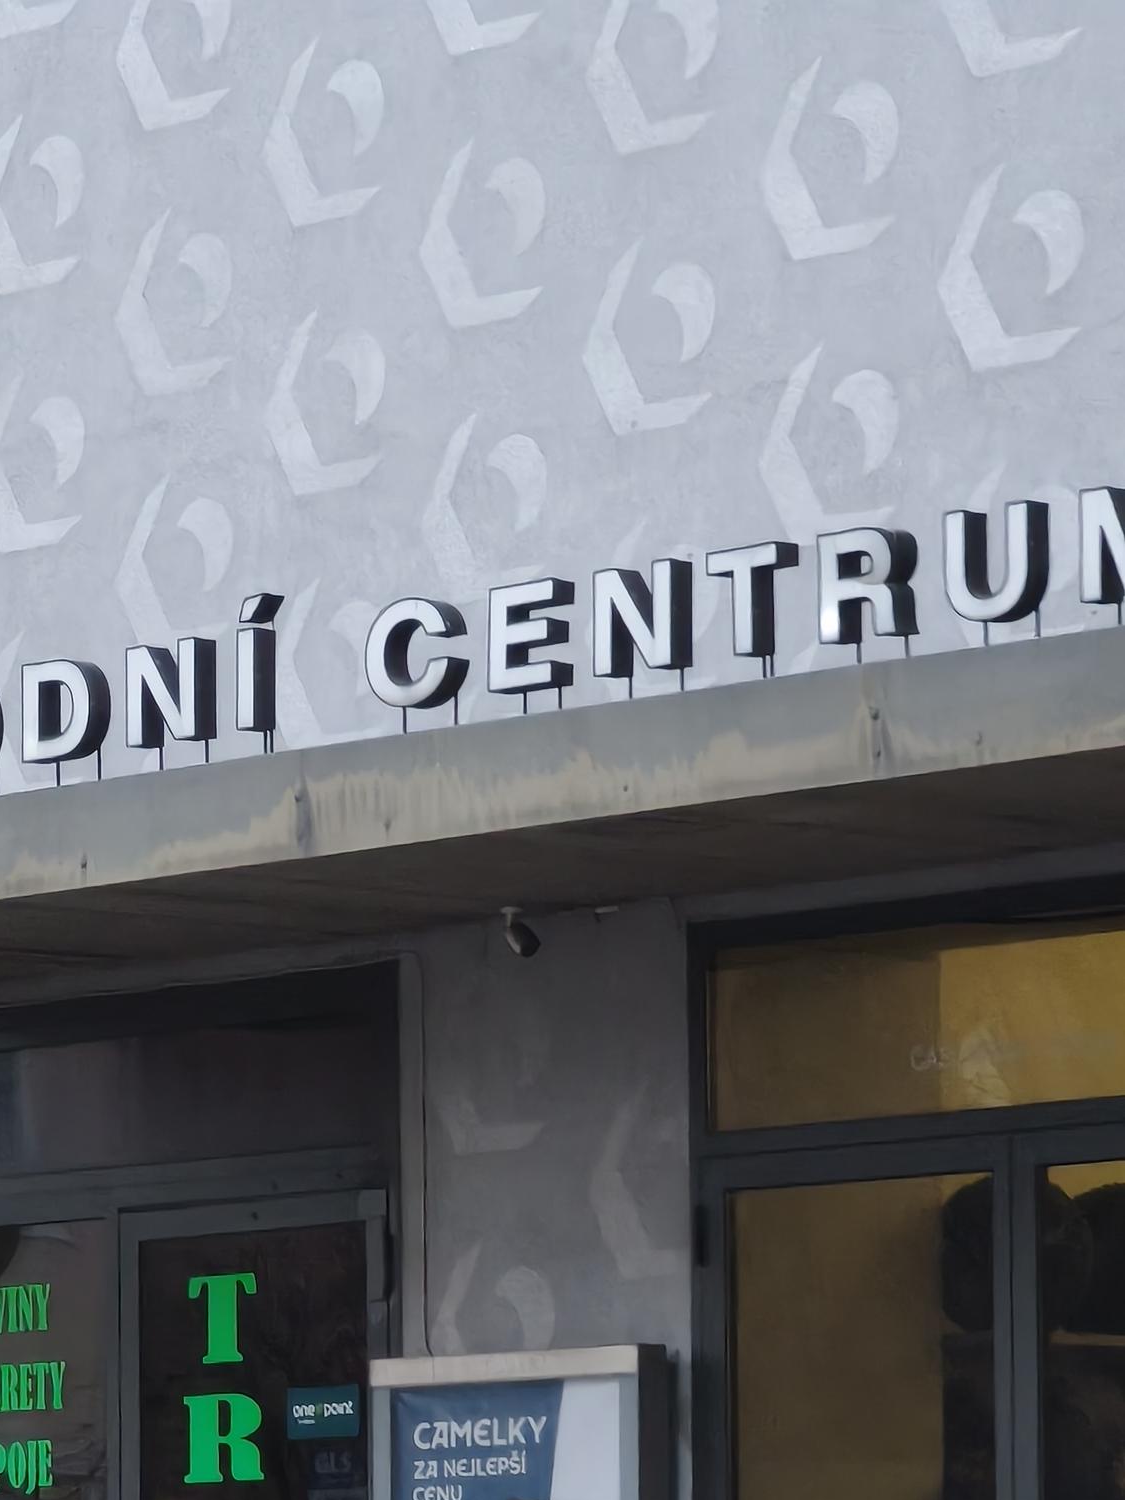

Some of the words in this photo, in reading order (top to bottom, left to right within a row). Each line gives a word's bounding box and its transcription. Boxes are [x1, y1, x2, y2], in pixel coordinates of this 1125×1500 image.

[413, 1416, 547, 1450] CAMELKY
[413, 1460, 438, 1480] ZA
[443, 1450, 526, 1478] NEJLEPŠÍ
